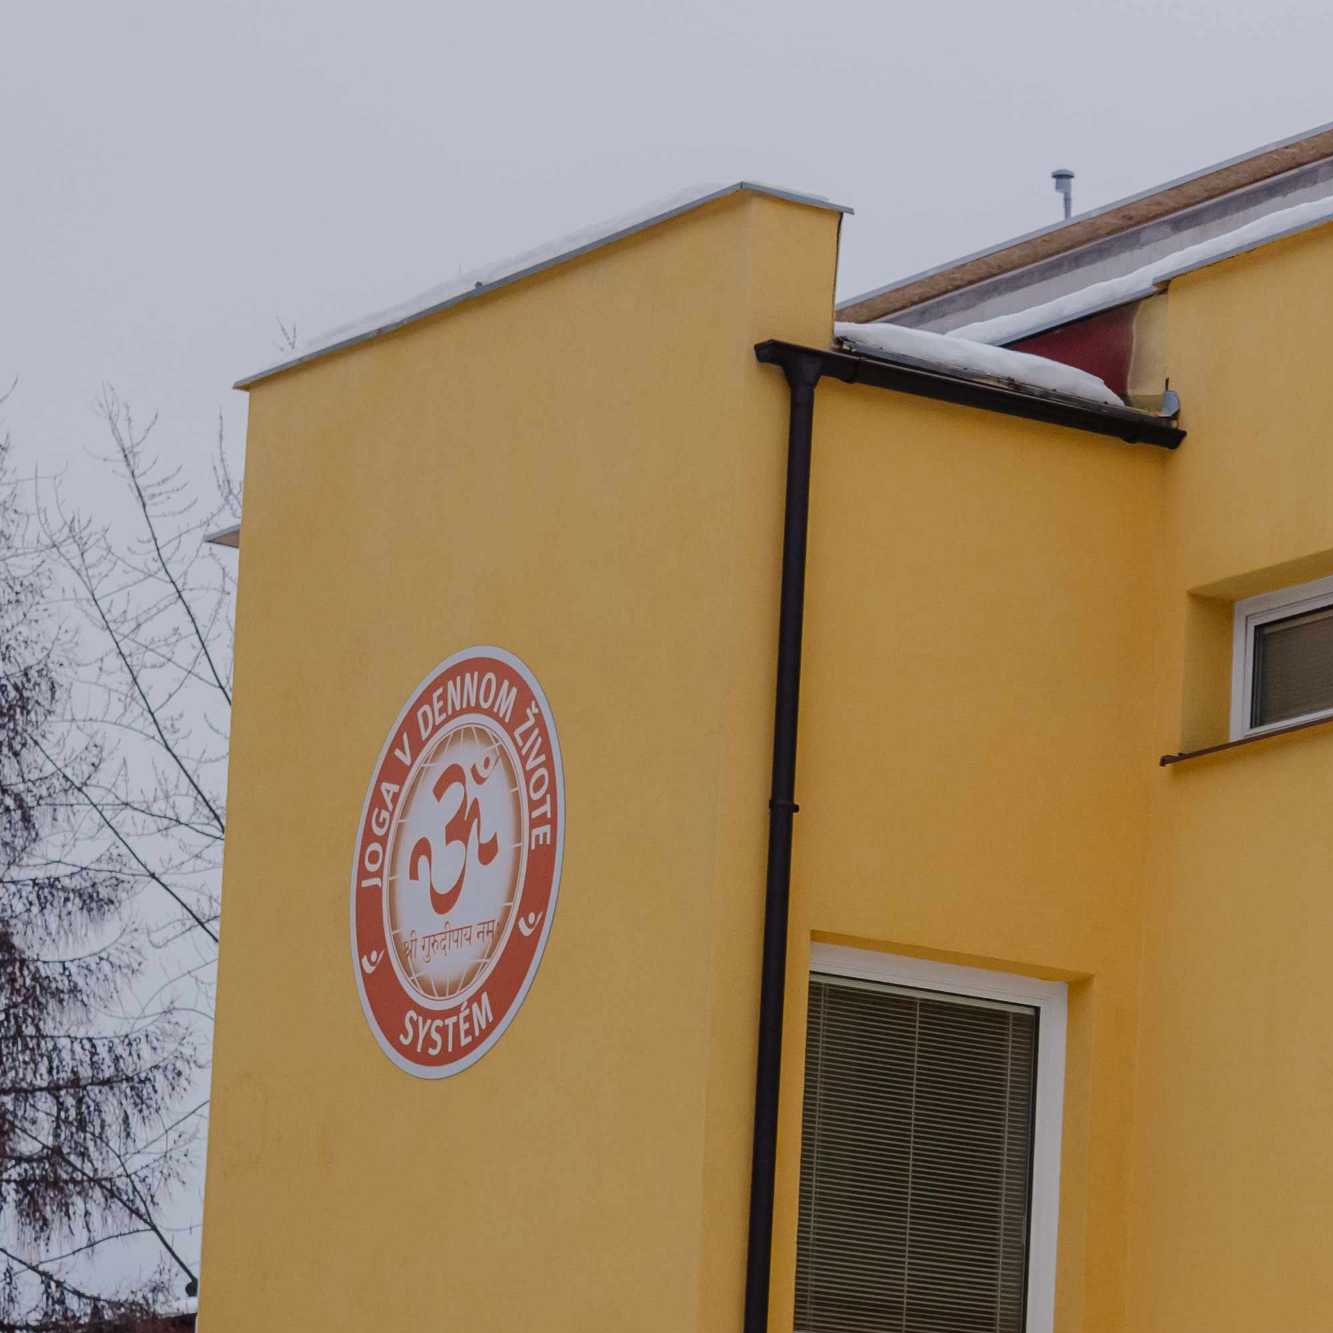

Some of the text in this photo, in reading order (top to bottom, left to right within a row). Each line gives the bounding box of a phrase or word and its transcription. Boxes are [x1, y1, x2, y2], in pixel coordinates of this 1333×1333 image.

[361, 671, 551, 888] JOGA V DENNOM ŽIVOTE
[400, 992, 493, 1056] SYSTÉM
